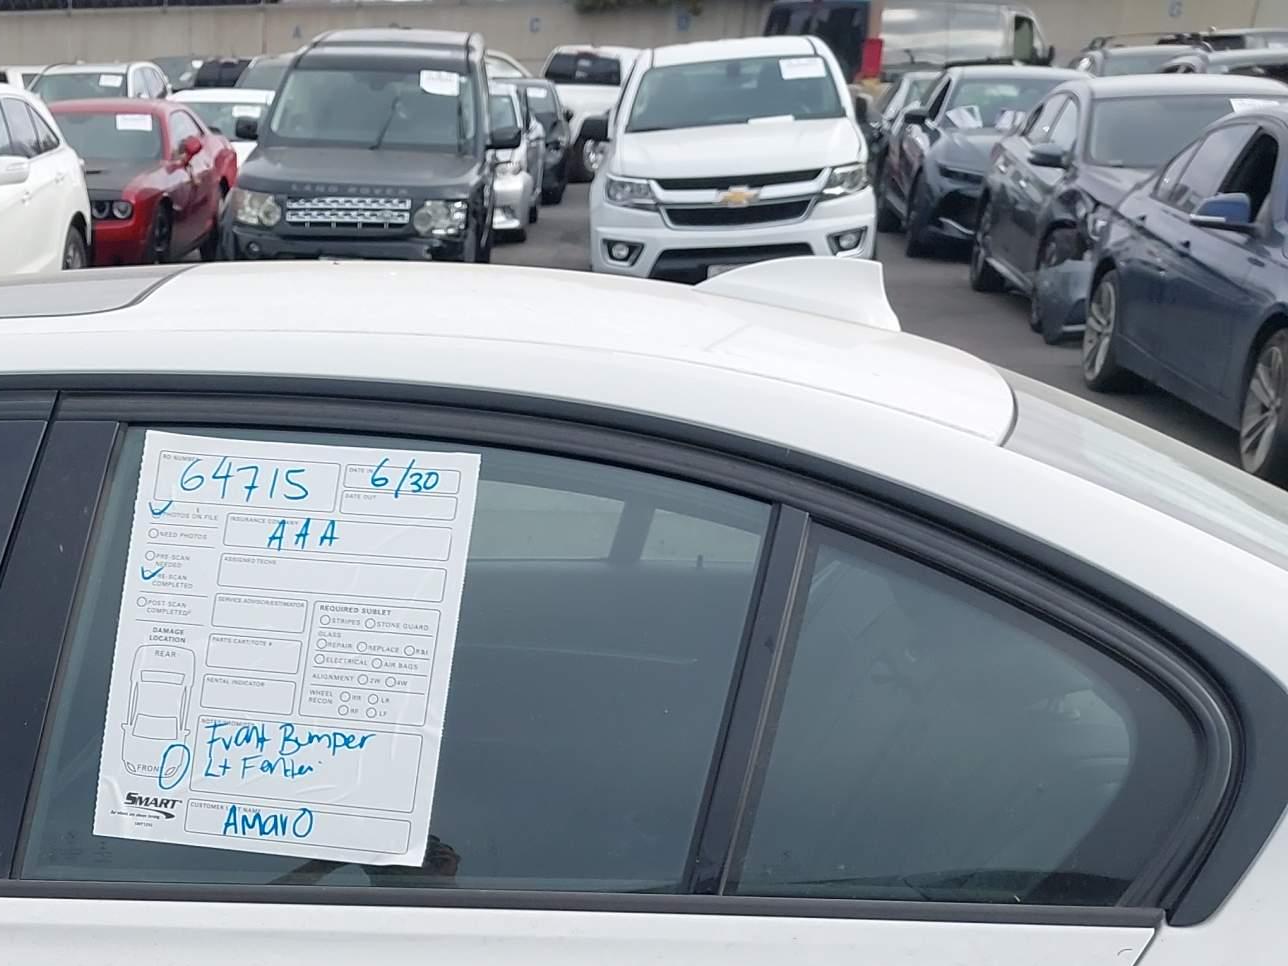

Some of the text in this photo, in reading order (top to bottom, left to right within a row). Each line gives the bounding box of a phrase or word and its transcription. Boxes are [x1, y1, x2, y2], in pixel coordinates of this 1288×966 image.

[180, 456, 309, 502] 64715
[370, 458, 440, 498] 6/30
[152, 580, 193, 589] COMPLETED
[319, 604, 392, 617] REQUIRED SUBLET
[332, 617, 429, 631] STRIPES STONE GUARD
[152, 626, 185, 636] DAMAGE
[317, 630, 342, 639] GLASS
[148, 634, 186, 644] LOCATION
[327, 641, 352, 649] REPAIR
[368, 645, 400, 654] REPLACE
[154, 649, 177, 658] REAR
[326, 656, 368, 666] ELECTRICAL
[312, 673, 355, 682] ALIGNMENT
[231, 679, 265, 688] INDICATOR
[309, 689, 333, 698] WHEEL
[308, 697, 334, 705] RECON
[279, 722, 377, 757] Bumper
[190, 801, 225, 810] CUSTOMER
